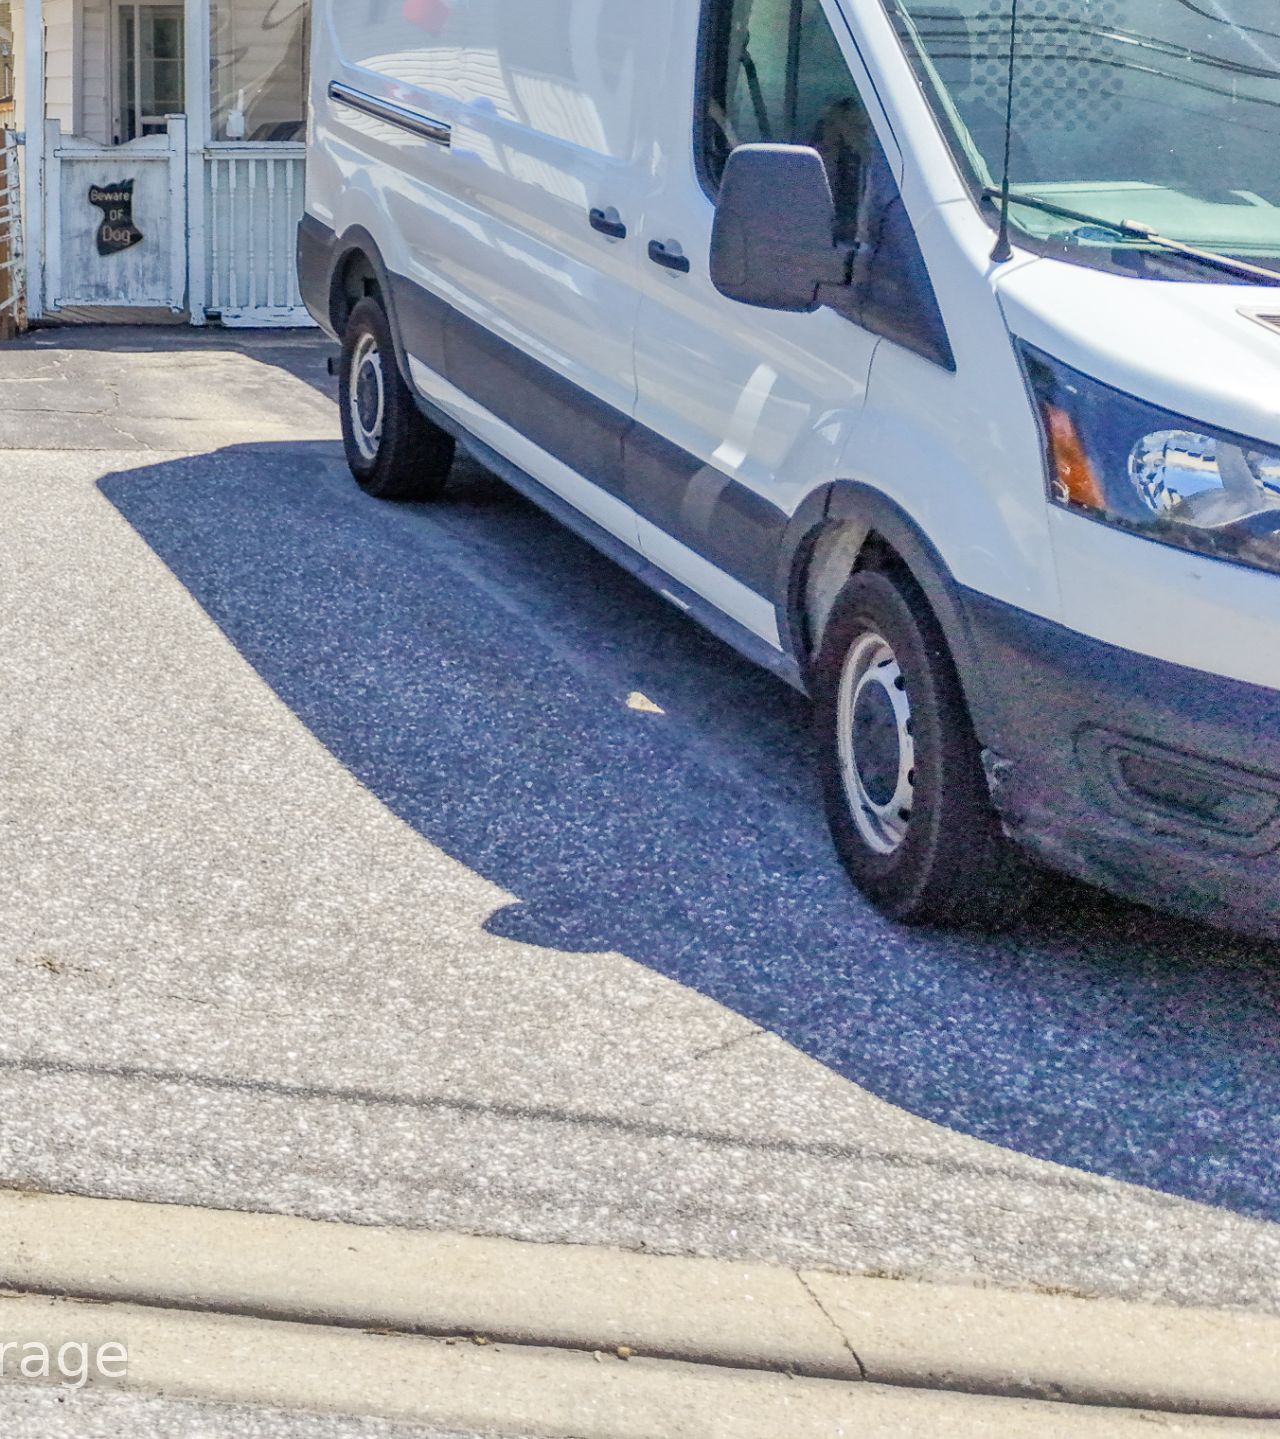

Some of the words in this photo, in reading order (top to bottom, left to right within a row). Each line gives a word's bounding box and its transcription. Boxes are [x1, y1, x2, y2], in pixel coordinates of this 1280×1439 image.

[90, 189, 130, 201] Beware
[109, 208, 124, 221] OF
[102, 225, 130, 245] Dog
